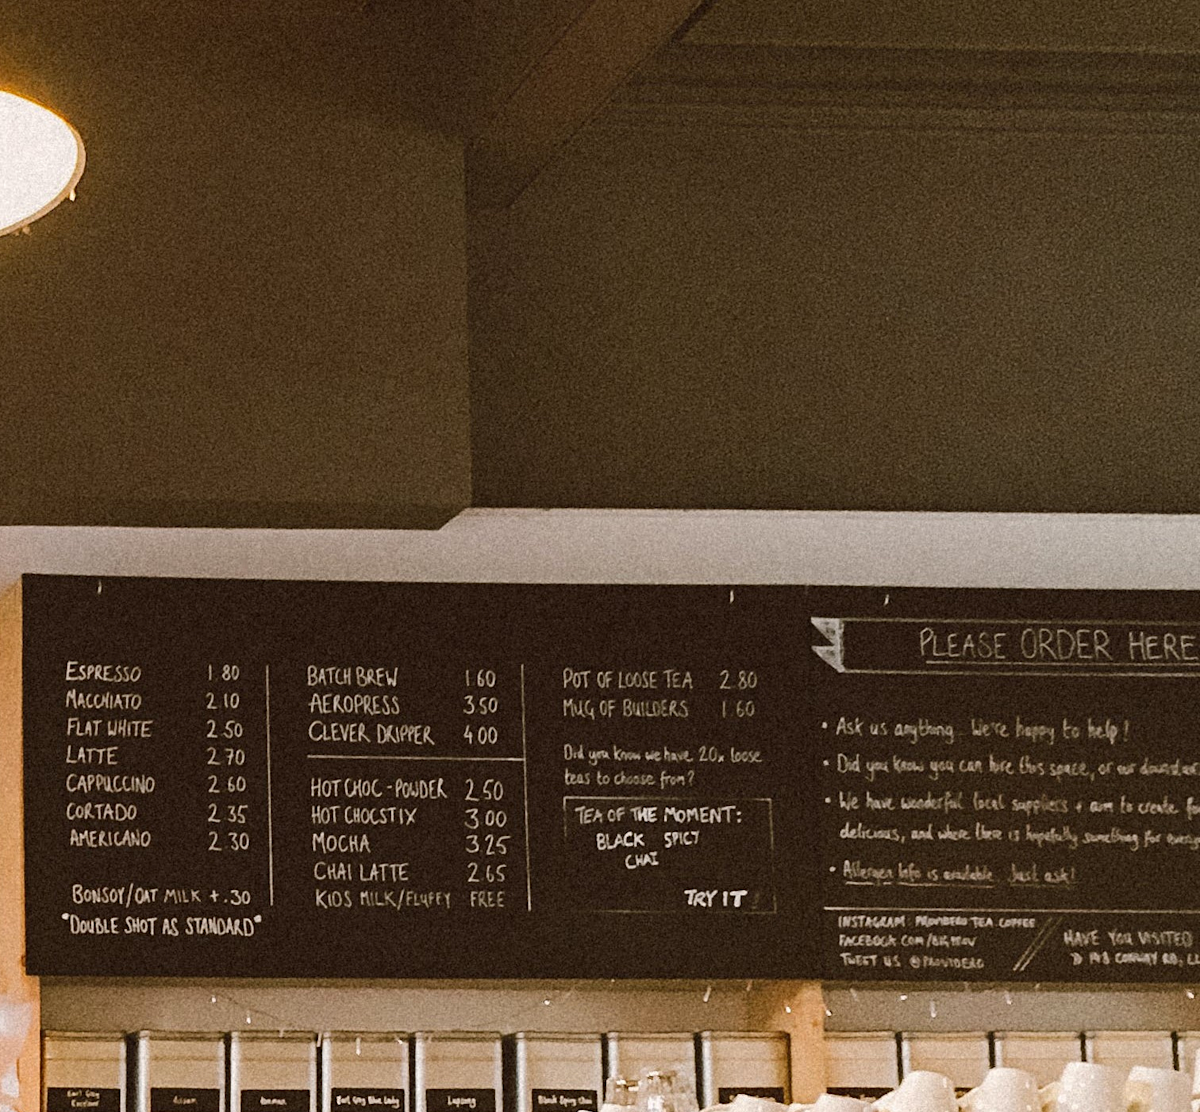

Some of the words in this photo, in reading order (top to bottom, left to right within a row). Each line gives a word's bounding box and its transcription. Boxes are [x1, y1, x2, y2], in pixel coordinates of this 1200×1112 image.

[919, 627, 1006, 659] PLEASE
[1021, 628, 1113, 661] ORDER
[1128, 630, 1200, 661] HERE
[66, 661, 142, 683] ESPRESSO
[307, 665, 351, 687] BATCH
[356, 666, 399, 687] BREW
[563, 667, 591, 689] POT
[597, 670, 613, 689] OF
[618, 671, 657, 689] LOOSE
[663, 669, 694, 689] TEA
[66, 689, 142, 710] MACCHIATO
[308, 693, 400, 716] AEROPRESS
[563, 698, 595, 720] MUG
[599, 699, 616, 718] OF
[622, 699, 689, 718] BUILDERS
[67, 718, 102, 736] FLAT
[108, 720, 154, 738] WHITE
[308, 720, 371, 743] CLEVER
[377, 723, 435, 746] DRIPPER
[836, 716, 863, 737] Ask
[870, 722, 887, 736] us
[1063, 717, 1080, 739] to
[66, 745, 118, 765] LATTE
[564, 744, 585, 761] Did
[589, 750, 610, 766] you
[664, 746, 694, 763] have
[730, 747, 763, 763] loose
[564, 768, 591, 786] teas
[597, 770, 610, 785] to
[614, 771, 655, 786] choose
[837, 753, 860, 774] Did
[865, 761, 889, 782] you
[929, 760, 954, 781] you
[959, 760, 983, 773] can
[66, 773, 155, 794] CAPPUCCINO
[311, 778, 342, 798] HOT
[839, 791, 860, 811] We
[66, 802, 137, 821] CORTADO
[311, 805, 341, 825] HOT
[575, 806, 602, 824] TEA
[607, 807, 625, 822] OF
[630, 806, 658, 823] THE
[664, 805, 742, 824] MOMENT:
[70, 829, 151, 848] AMERICANO
[311, 831, 371, 854] MOCHA
[596, 831, 645, 850] BLACK
[625, 851, 659, 869] CHAI
[313, 861, 352, 881] CHAI
[359, 862, 409, 882] LATTE
[164, 889, 201, 904] MILK
[470, 891, 505, 908] FREE
[684, 889, 718, 907] TRY
[722, 890, 748, 908] IT
[124, 916, 158, 936] SHOT
[162, 918, 179, 936] AS
